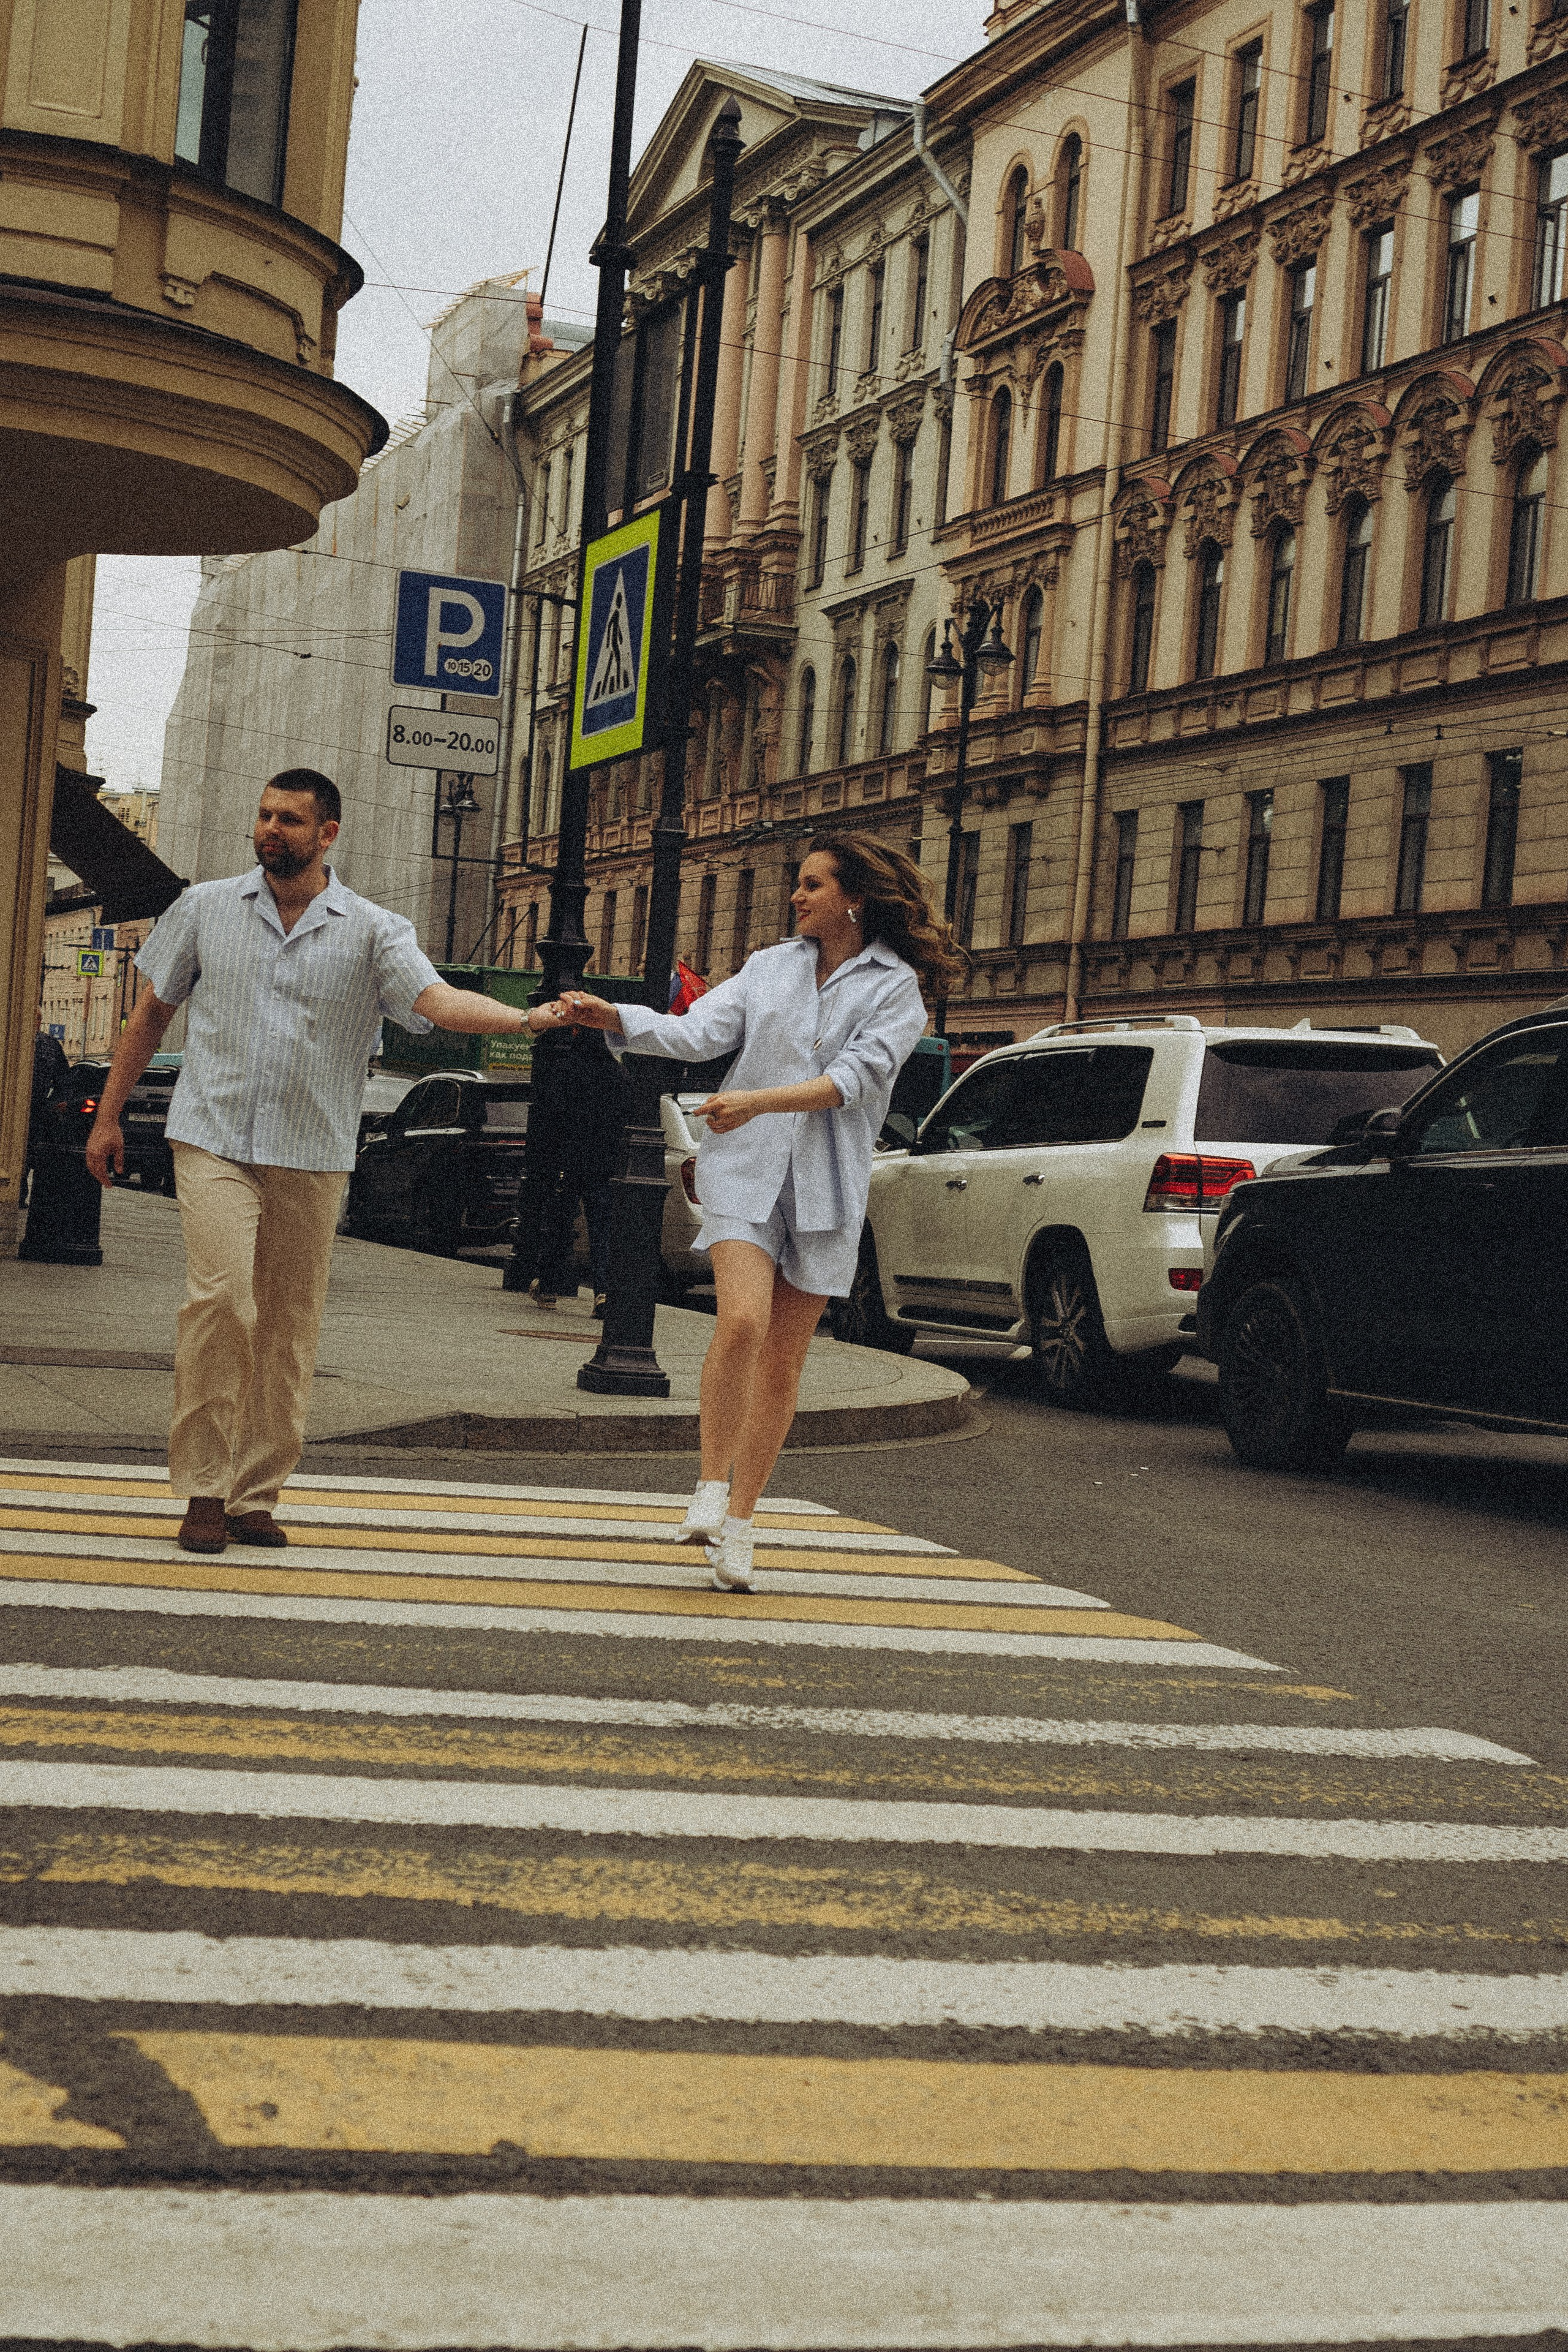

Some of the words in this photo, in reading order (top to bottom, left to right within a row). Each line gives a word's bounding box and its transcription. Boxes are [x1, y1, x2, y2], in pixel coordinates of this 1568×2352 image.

[424, 586, 486, 677] P
[448, 662, 457, 670] 10
[458, 662, 470, 673] 15
[473, 663, 491, 677] 20
